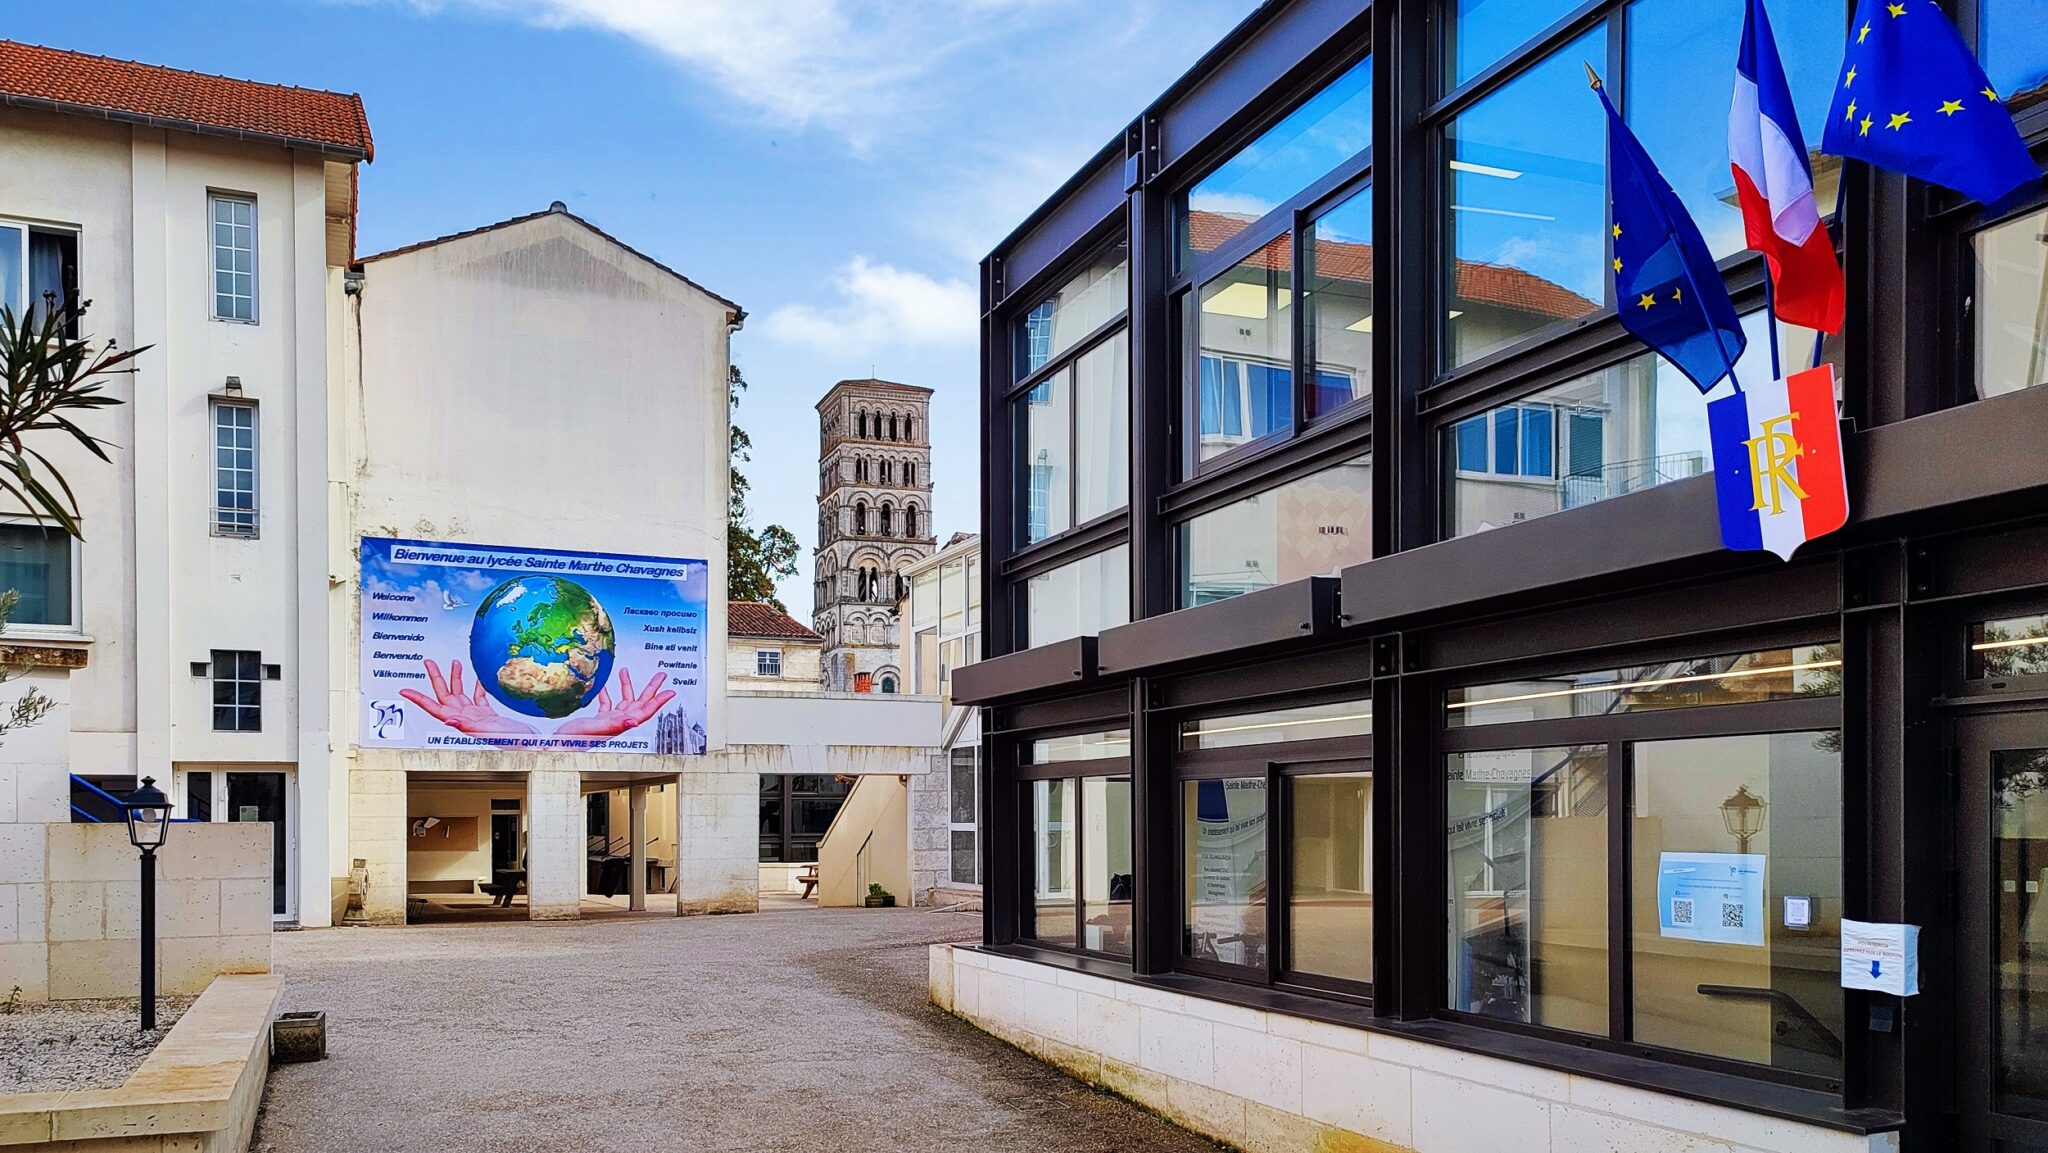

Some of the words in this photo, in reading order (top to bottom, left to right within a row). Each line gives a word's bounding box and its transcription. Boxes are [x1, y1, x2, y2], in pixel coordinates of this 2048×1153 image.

[394, 548, 465, 564] Bienvenue
[467, 556, 485, 565] au
[486, 554, 522, 568] lycée
[525, 556, 566, 570] Sainte
[568, 559, 613, 573] Marthe
[616, 562, 684, 578] Chavagnes
[372, 592, 415, 602] Welcome
[372, 612, 428, 622] Willkommen
[643, 624, 665, 633] Xush
[372, 631, 425, 641] Bienvenido
[644, 642, 664, 651] Bine
[677, 644, 698, 652] venit
[373, 651, 424, 661] Benvenuto
[657, 660, 698, 669] Powitanie
[373, 669, 426, 679] Välkommen
[672, 678, 698, 686] Sveiki
[428, 736, 441, 745] UN
[443, 735, 521, 747] ÉTABLISSEMENT
[521, 738, 538, 747] QUI
[540, 739, 560, 747] FAIT
[561, 739, 588, 748] VIVRE
[588, 740, 607, 748] SES
[608, 740, 649, 749] PROJETS
[1447, 769, 1464, 781] ainte
